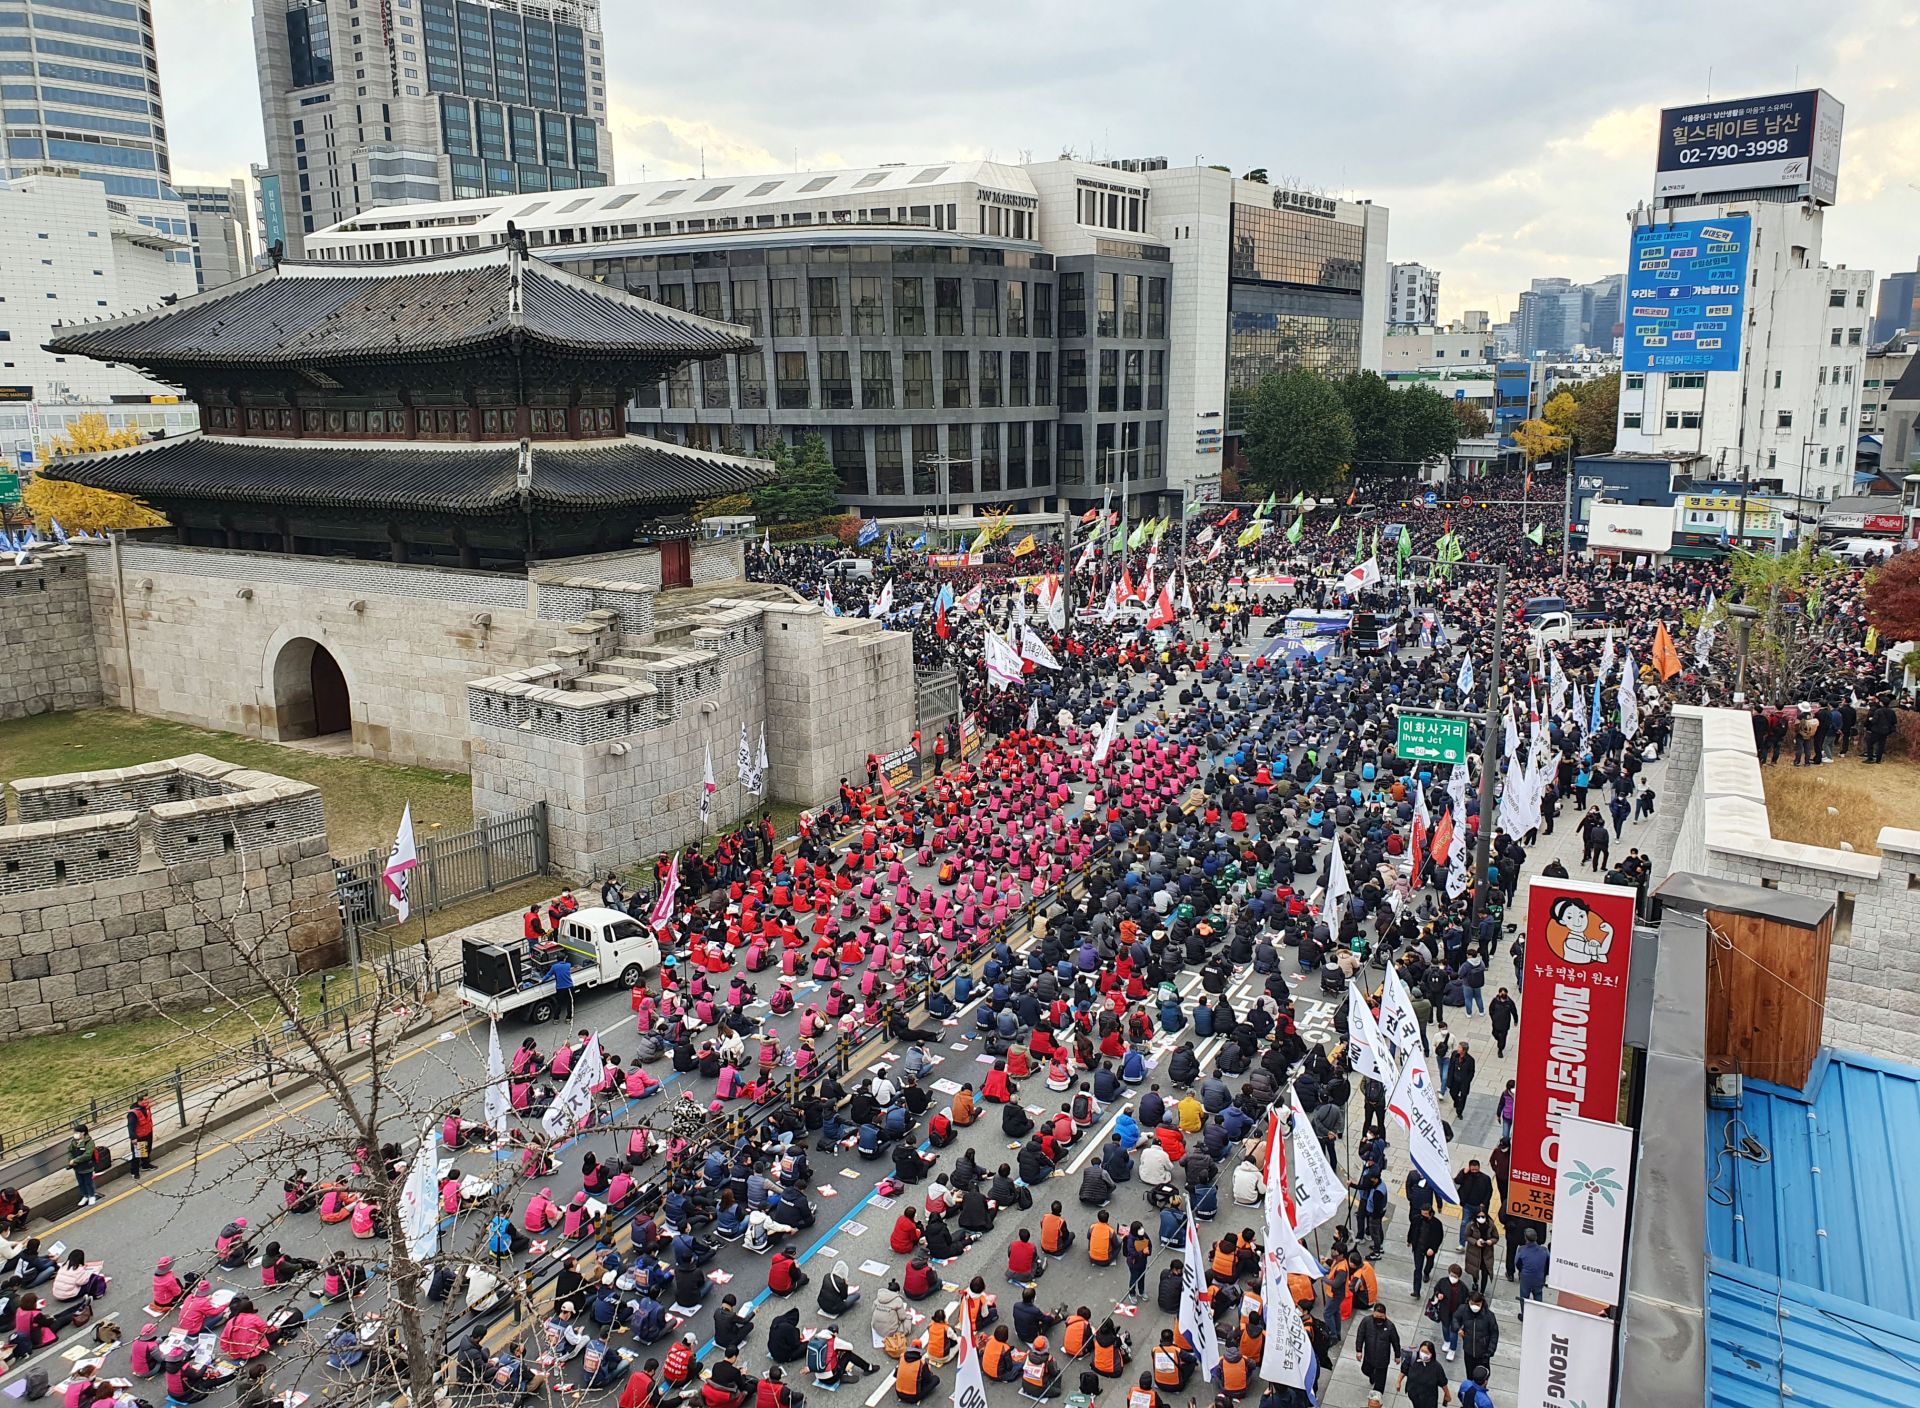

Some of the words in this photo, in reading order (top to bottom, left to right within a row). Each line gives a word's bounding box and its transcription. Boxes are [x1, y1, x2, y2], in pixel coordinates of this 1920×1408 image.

[389, 38, 400, 98] SKYPARK
[1681, 113, 1712, 122] 서울중심과
[1713, 109, 1745, 118] 남산생활을
[1746, 106, 1765, 114] 마음껏
[1767, 102, 1792, 111] 소유하다
[1672, 119, 1759, 146] 힐스테이트
[1765, 113, 1802, 136] 남산
[1679, 138, 1788, 164] 02-790-3998
[977, 189, 992, 201] JW
[992, 191, 1039, 210] MARRIOTT
[1631, 289, 1656, 299] 우리는
[1692, 284, 1740, 295] 가능합니다
[1656, 354, 1714, 366] 더불어민주당
[1403, 721, 1464, 737] 이화사거리
[1403, 733, 1424, 743] Ihwa
[1427, 736, 1442, 744] Jct
[1591, 971, 1620, 989] 원조!
[1511, 1169, 1551, 1186] 창업문의
[1556, 1257, 1579, 1270] JEONG
[1581, 1263, 1615, 1278] GEURIDA
[1547, 1333, 1569, 1399] JEONG
